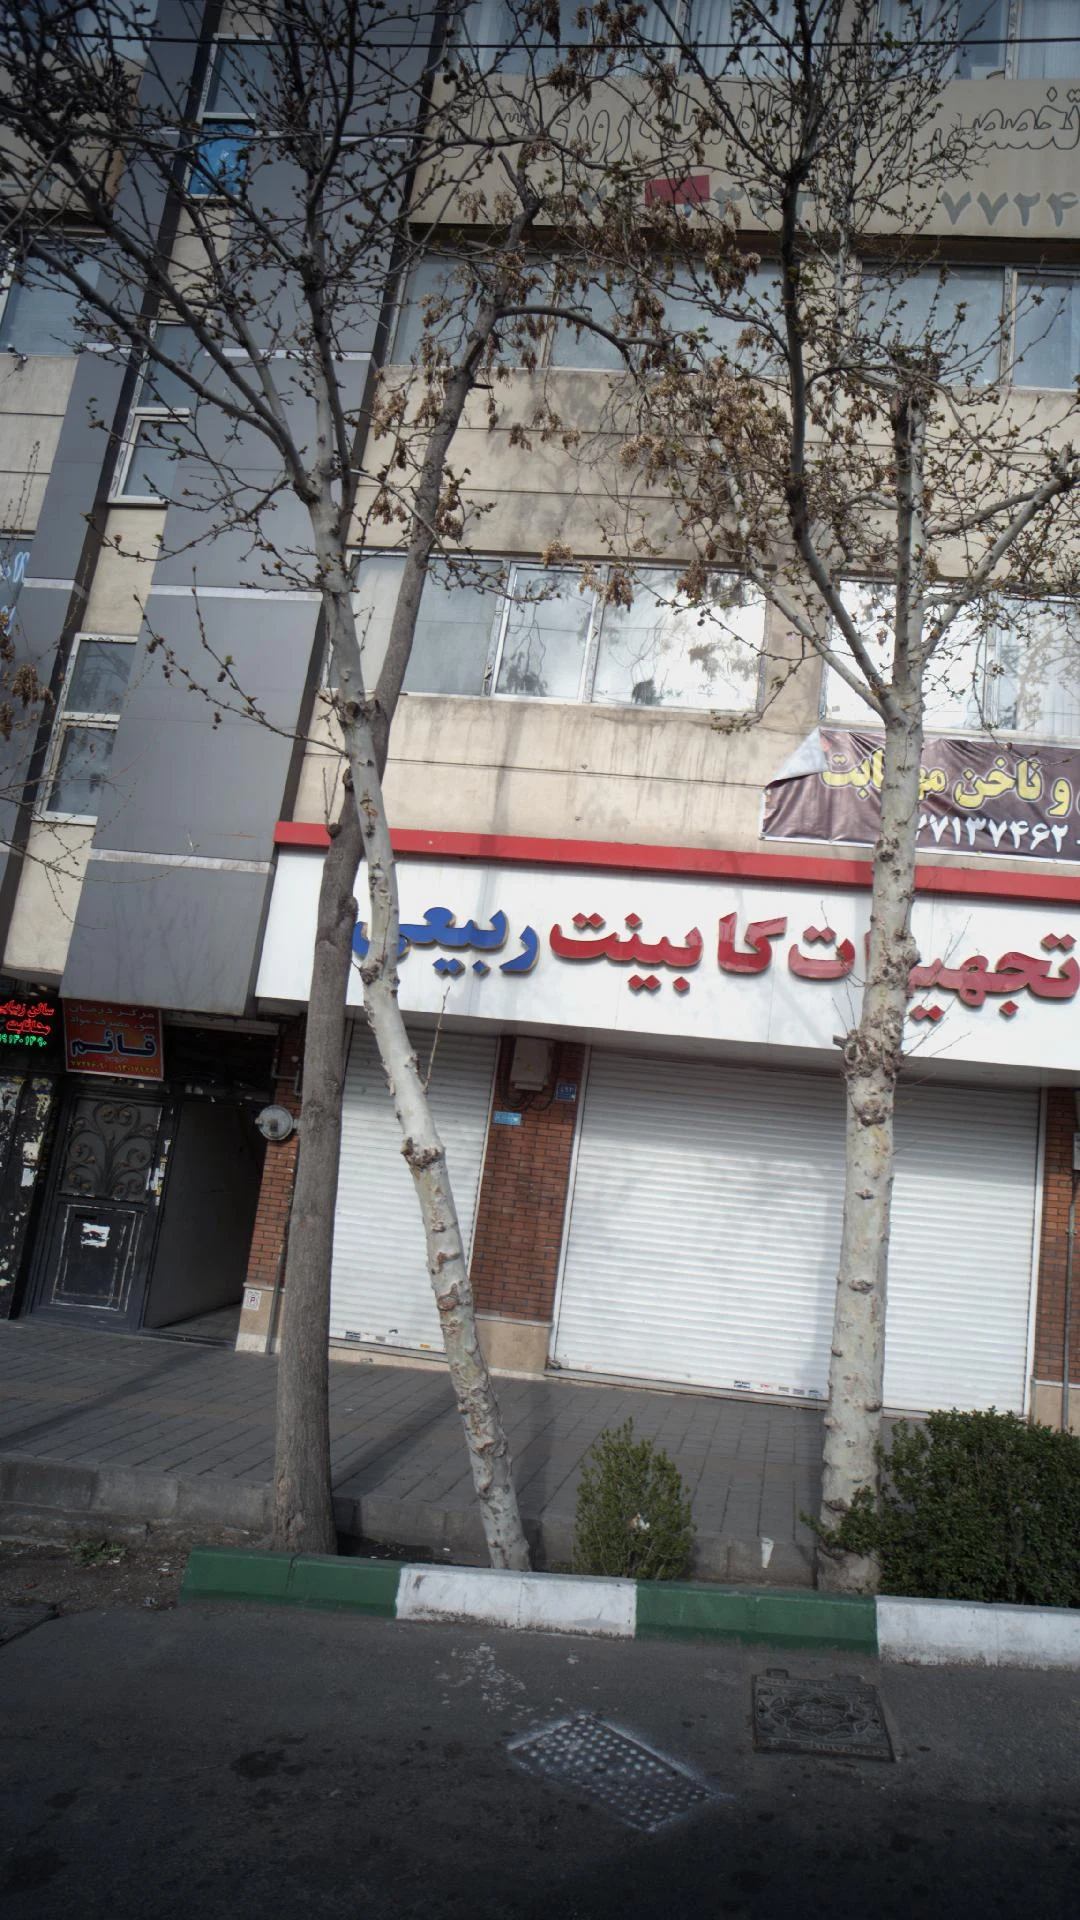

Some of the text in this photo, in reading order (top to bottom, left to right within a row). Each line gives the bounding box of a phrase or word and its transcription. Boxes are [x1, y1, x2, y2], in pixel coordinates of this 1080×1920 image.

[954, 756, 1042, 809] ناخن
[1049, 777, 1071, 818] و
[549, 910, 788, 998] کابینت
[787, 930, 1080, 1024] تجهیت
[70, 1028, 157, 1058] قائم
